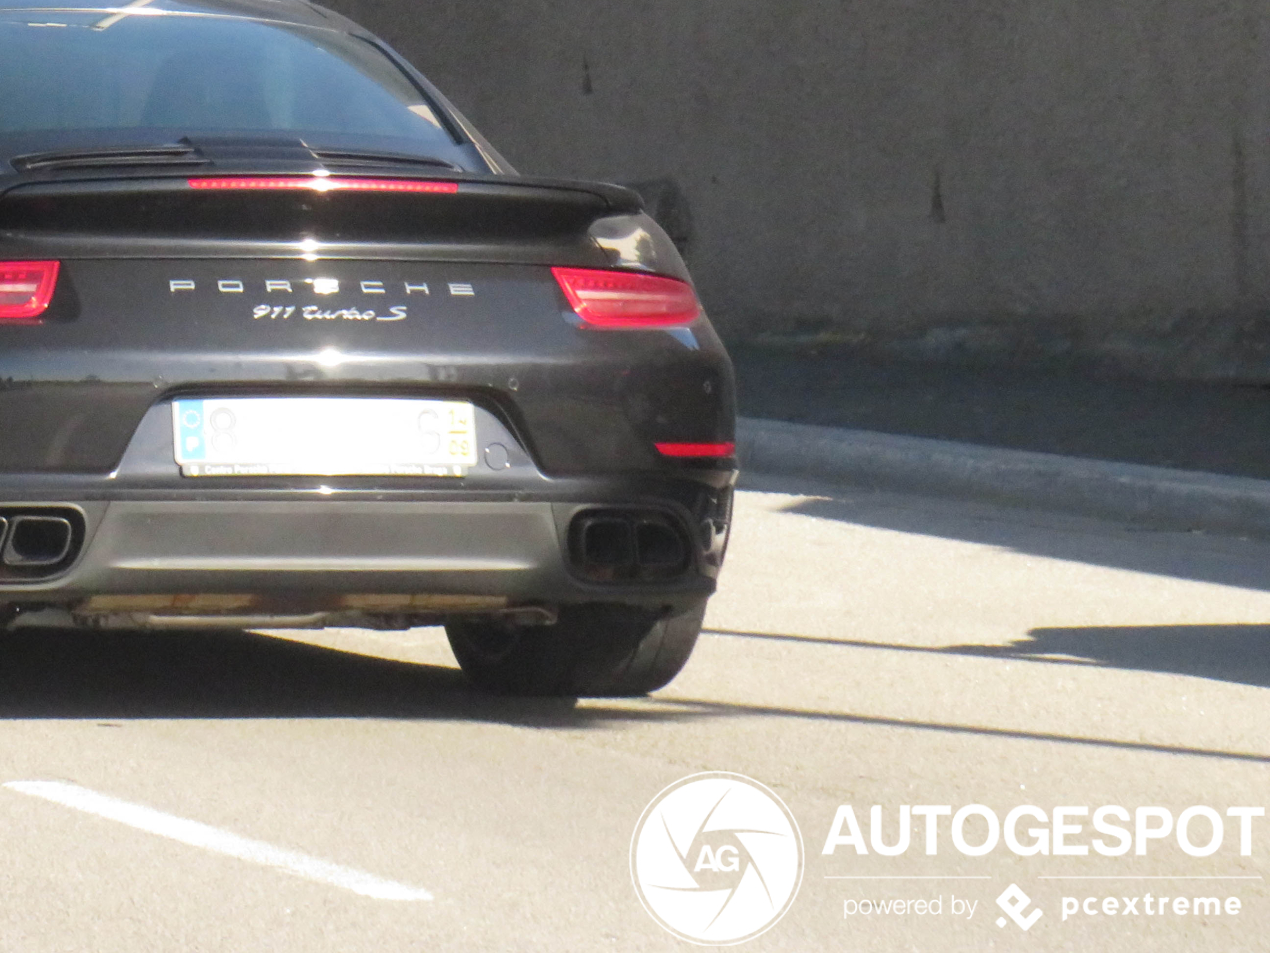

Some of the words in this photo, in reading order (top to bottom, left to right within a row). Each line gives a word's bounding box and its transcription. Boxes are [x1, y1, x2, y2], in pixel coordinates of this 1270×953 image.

[169, 279, 475, 296] PORSCHE
[253, 304, 295, 319] 911
[376, 305, 408, 321] S
